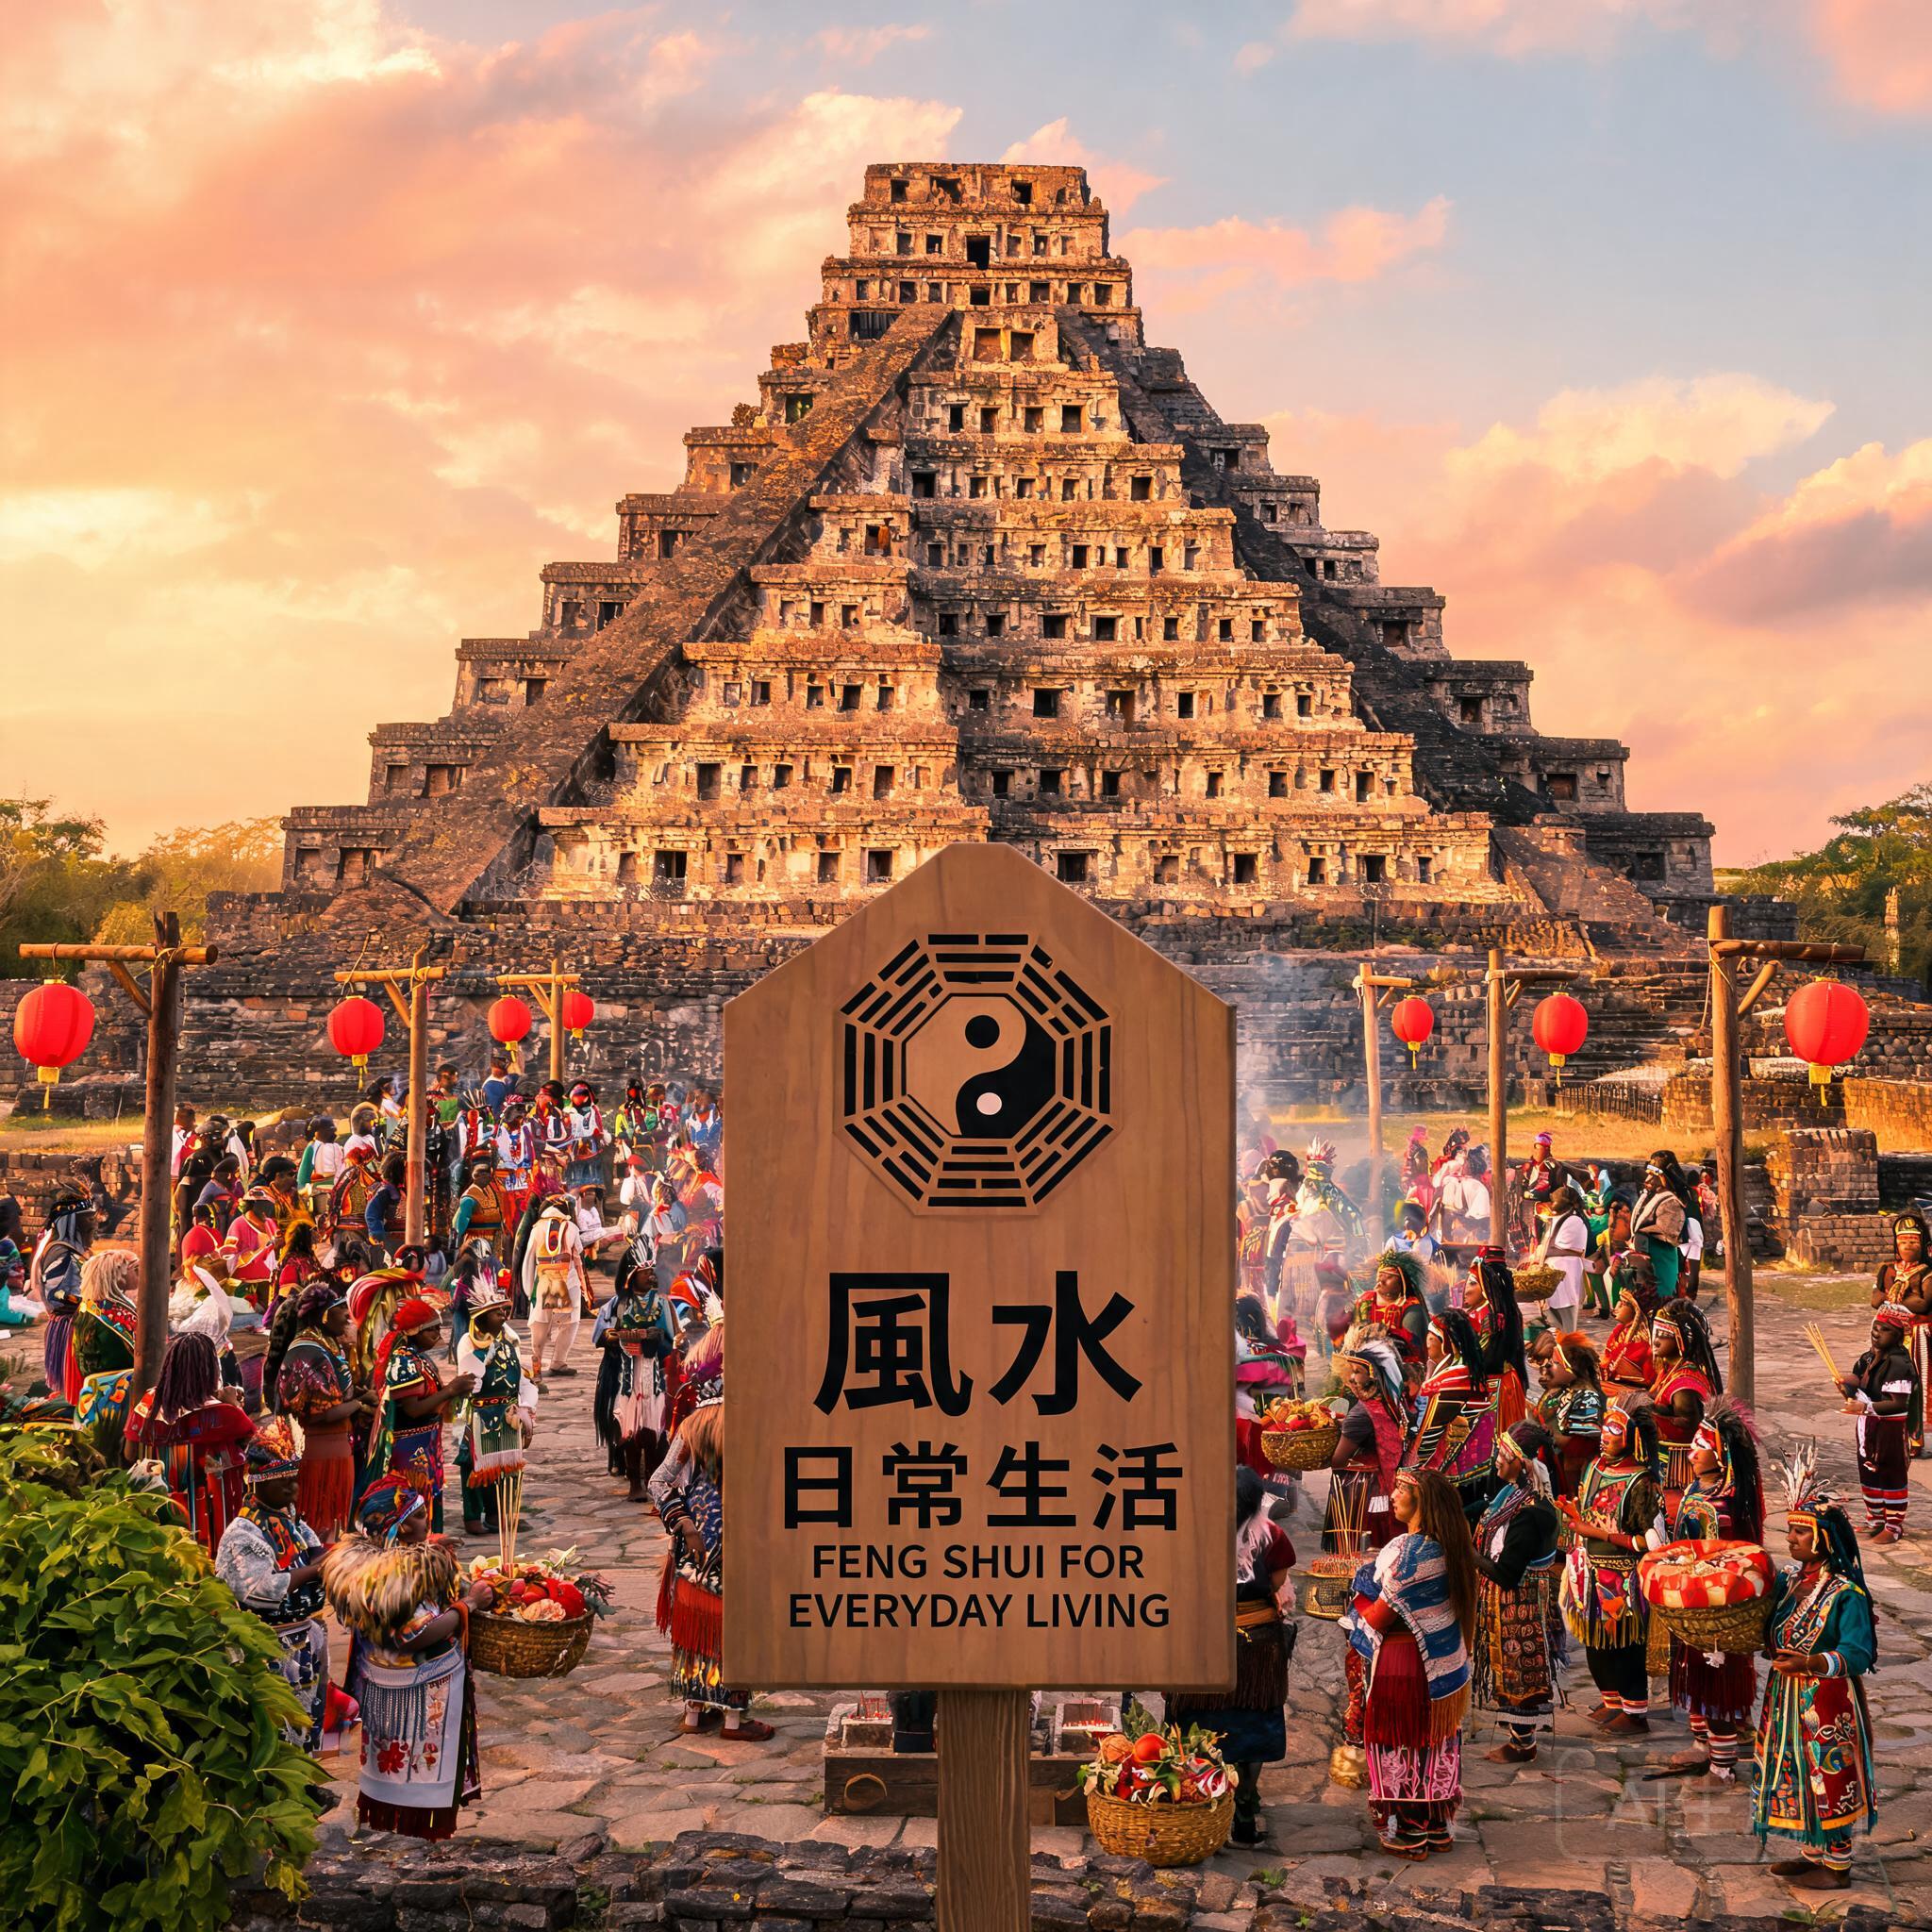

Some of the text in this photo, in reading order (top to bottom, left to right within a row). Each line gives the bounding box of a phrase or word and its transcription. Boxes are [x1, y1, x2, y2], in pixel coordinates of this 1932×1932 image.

[813, 1271, 1142, 1416] 風水
[783, 1441, 1183, 1530] 日常生活
[813, 1544, 1144, 1578] FENG SHUI FOR
[790, 1593, 1169, 1627] EVERYDAY LIVING
